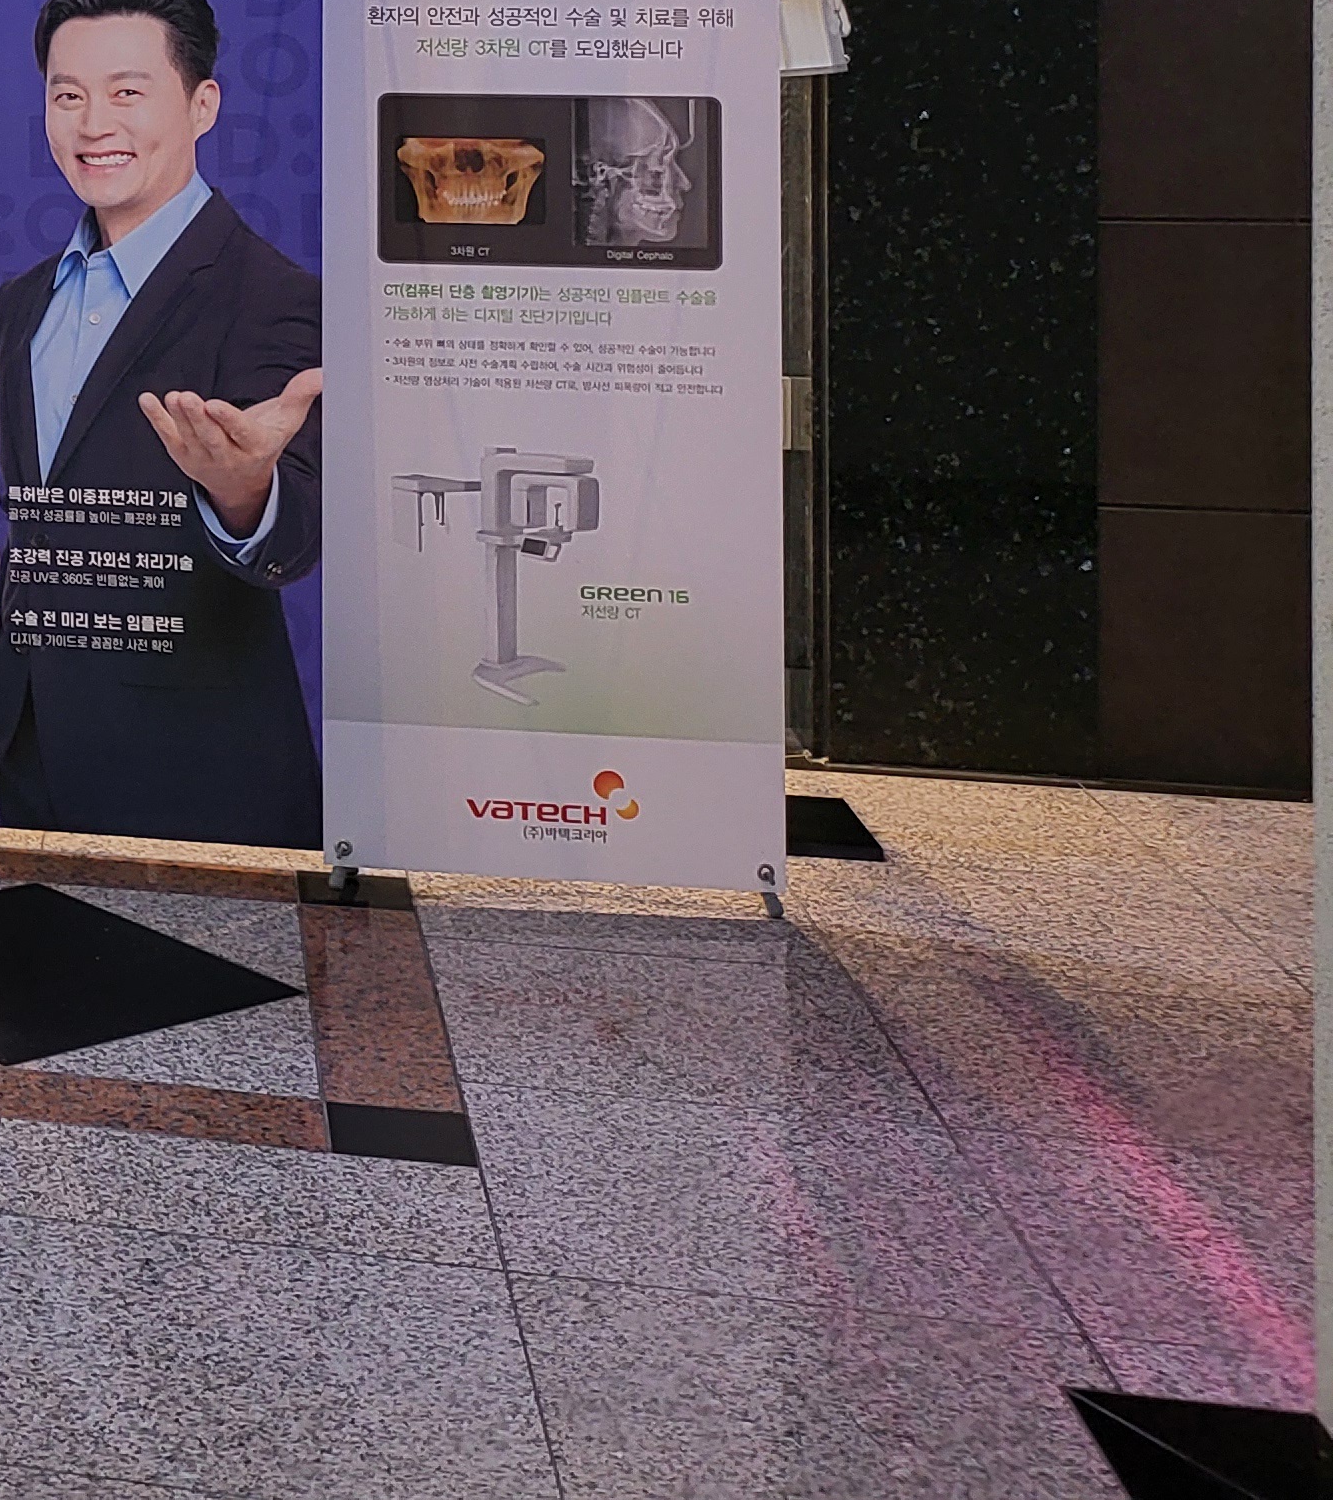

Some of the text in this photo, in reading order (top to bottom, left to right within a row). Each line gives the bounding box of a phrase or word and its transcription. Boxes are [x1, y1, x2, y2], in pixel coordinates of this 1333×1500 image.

[367, 6, 734, 29] 환자의 안전과 성공적인 수술 및 치료를 위해
[416, 39, 684, 60] 저선량 3차원 CT를 도입했습니다
[607, 250, 673, 261] Digital Cephalo
[383, 283, 717, 305] CT(컴퓨터 단층 촬영기기)는 성공적인 임플란트 수술을
[8, 486, 188, 508] 특허받은 이중표면처리 기술
[9, 548, 193, 572] 초강력 진공 자외선 처리기술
[9, 571, 165, 590] 진공 UV로 360도 빈틈없는 케어
[668, 589, 690, 604] 16
[10, 610, 185, 633] 수술 전 미리 보는 임플란트
[523, 825, 607, 844] (주)바텍코리아
